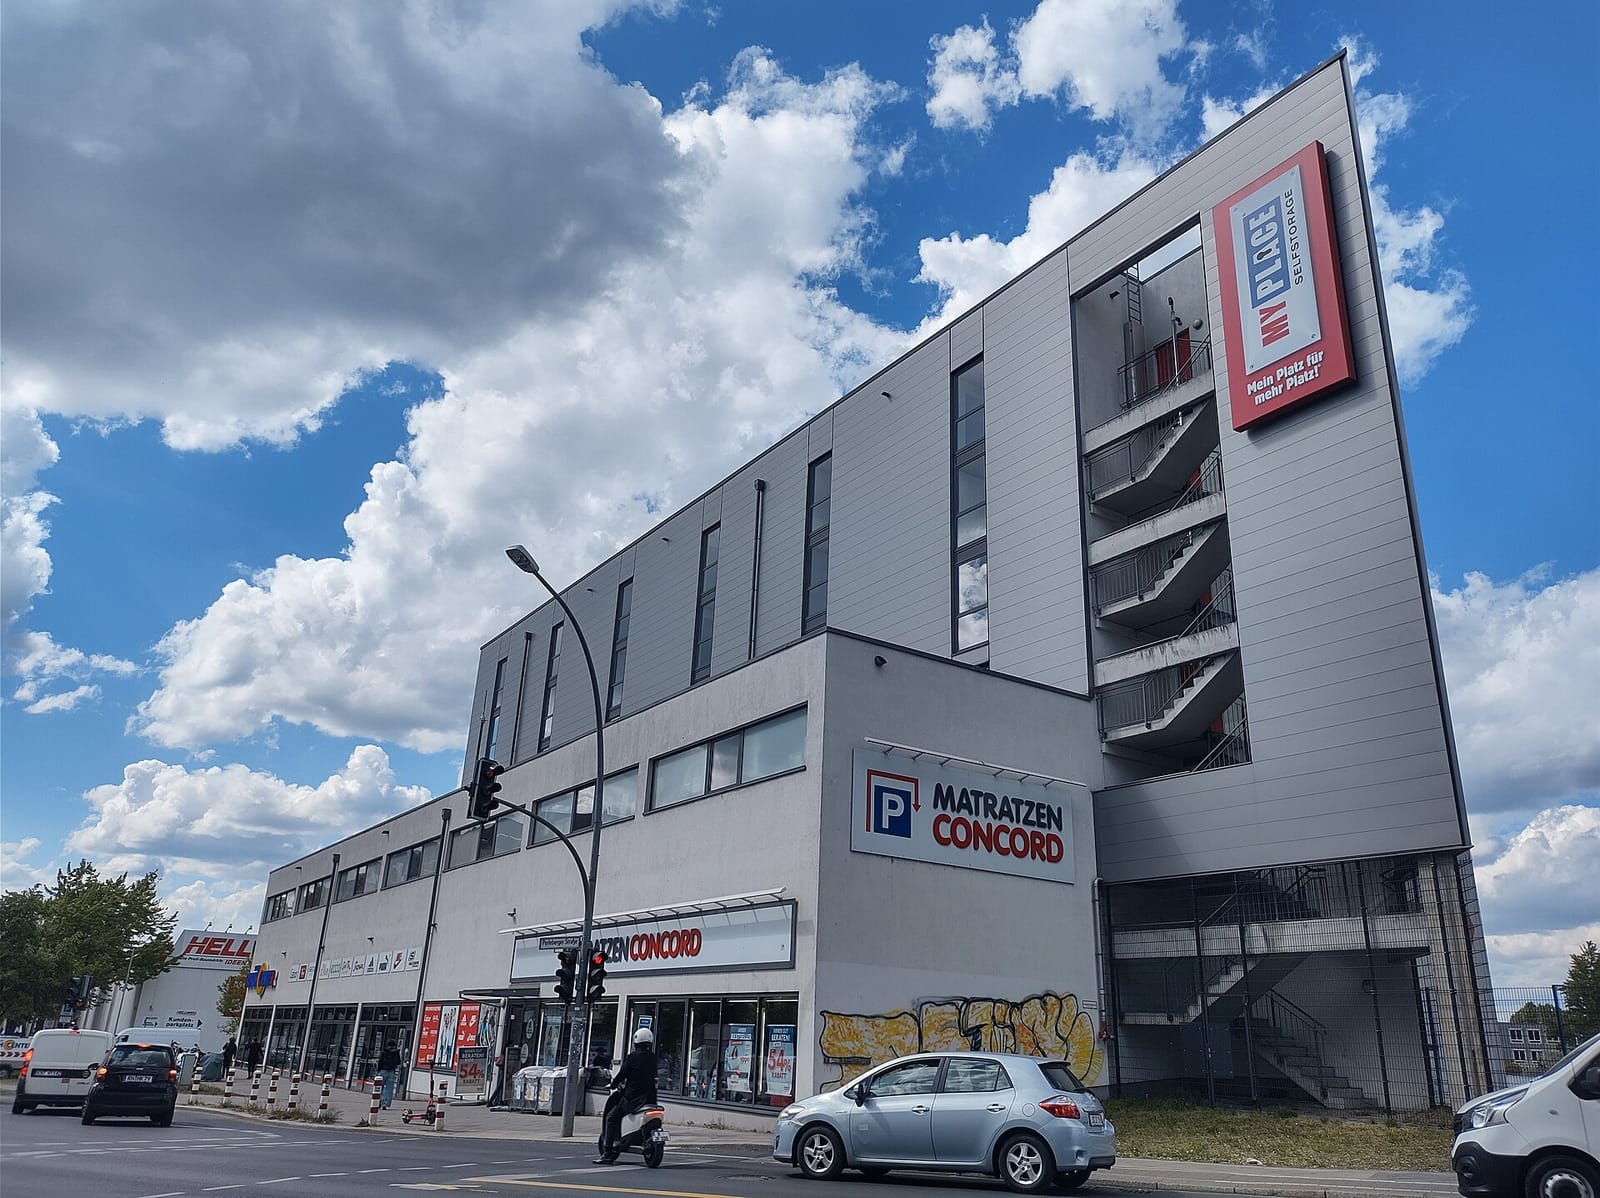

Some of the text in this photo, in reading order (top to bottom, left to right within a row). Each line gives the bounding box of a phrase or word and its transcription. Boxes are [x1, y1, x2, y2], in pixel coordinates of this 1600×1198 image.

[1284, 188, 1303, 286] SELFSTORAGE
[1249, 204, 1290, 347] MY PLACE
[1247, 351, 1324, 396] Mein Platz für
[1254, 365, 1319, 406] mehr Platz!
[932, 781, 1064, 832] MATRATZEN
[932, 813, 1065, 864] CONCORD
[184, 936, 252, 957] HELL
[629, 928, 702, 962] CONCORD
[459, 1062, 485, 1079] 54%
[768, 1048, 791, 1072] 54%
